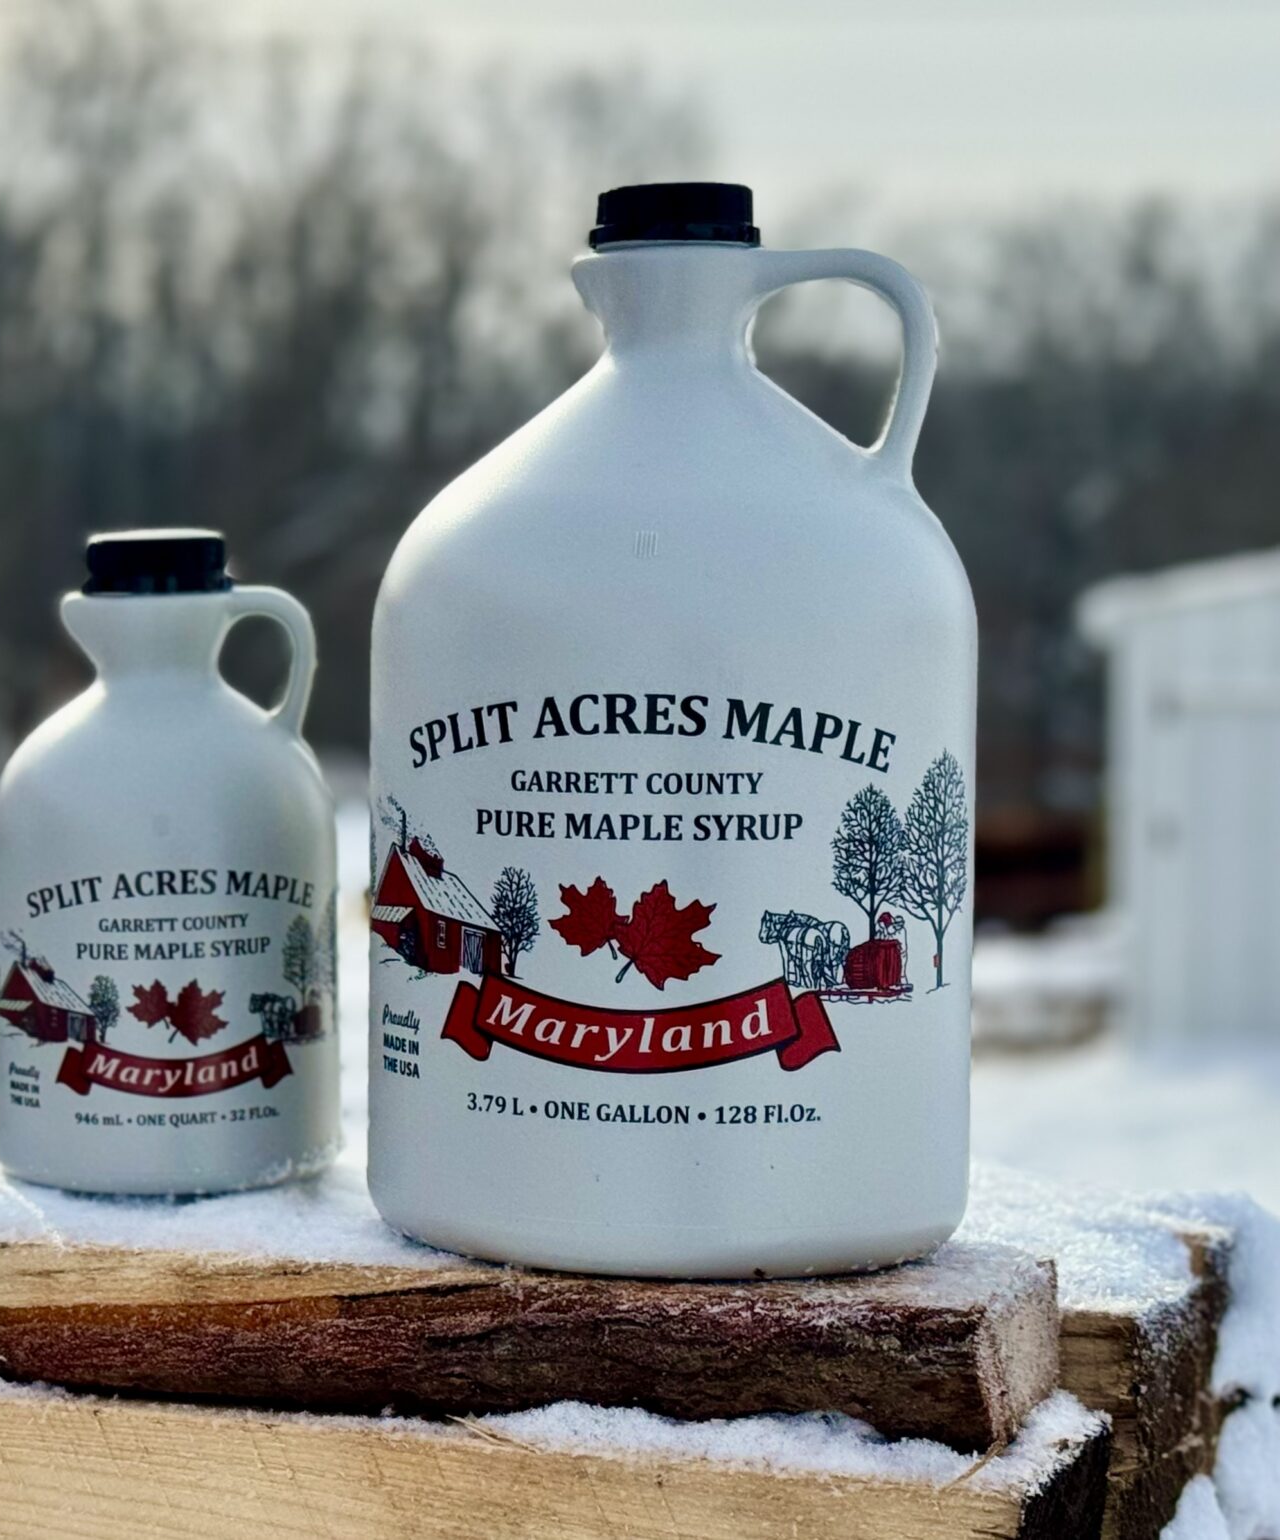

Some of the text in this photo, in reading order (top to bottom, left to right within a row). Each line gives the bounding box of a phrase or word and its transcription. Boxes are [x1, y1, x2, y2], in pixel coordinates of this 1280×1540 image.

[409, 694, 897, 774] SPLIT ACRES MAPLE
[510, 769, 764, 797] GARRETT COUNTY
[475, 809, 804, 842] PURE MAPLE SYRUP
[26, 869, 315, 918] SPLIT ACRES MAPLE
[98, 913, 249, 933] GARRETT COUNTY
[76, 937, 271, 961] PURE MAPLE SYRUP
[382, 1003, 420, 1035] Proudly
[486, 994, 772, 1063] Maryland
[383, 1033, 419, 1056] MADE IN
[86, 1047, 261, 1093] Maryland
[383, 1054, 420, 1079] THE USA
[74, 1112, 99, 1126] 946
[136, 1114, 166, 1126] ONE
[169, 1111, 217, 1128] QUART
[230, 1109, 245, 1122] 32
[467, 1092, 507, 1114] 3.79
[512, 1098, 524, 1116] L
[544, 1100, 590, 1121] ONE
[595, 1103, 691, 1125] GALLON
[714, 1105, 758, 1125] 128
